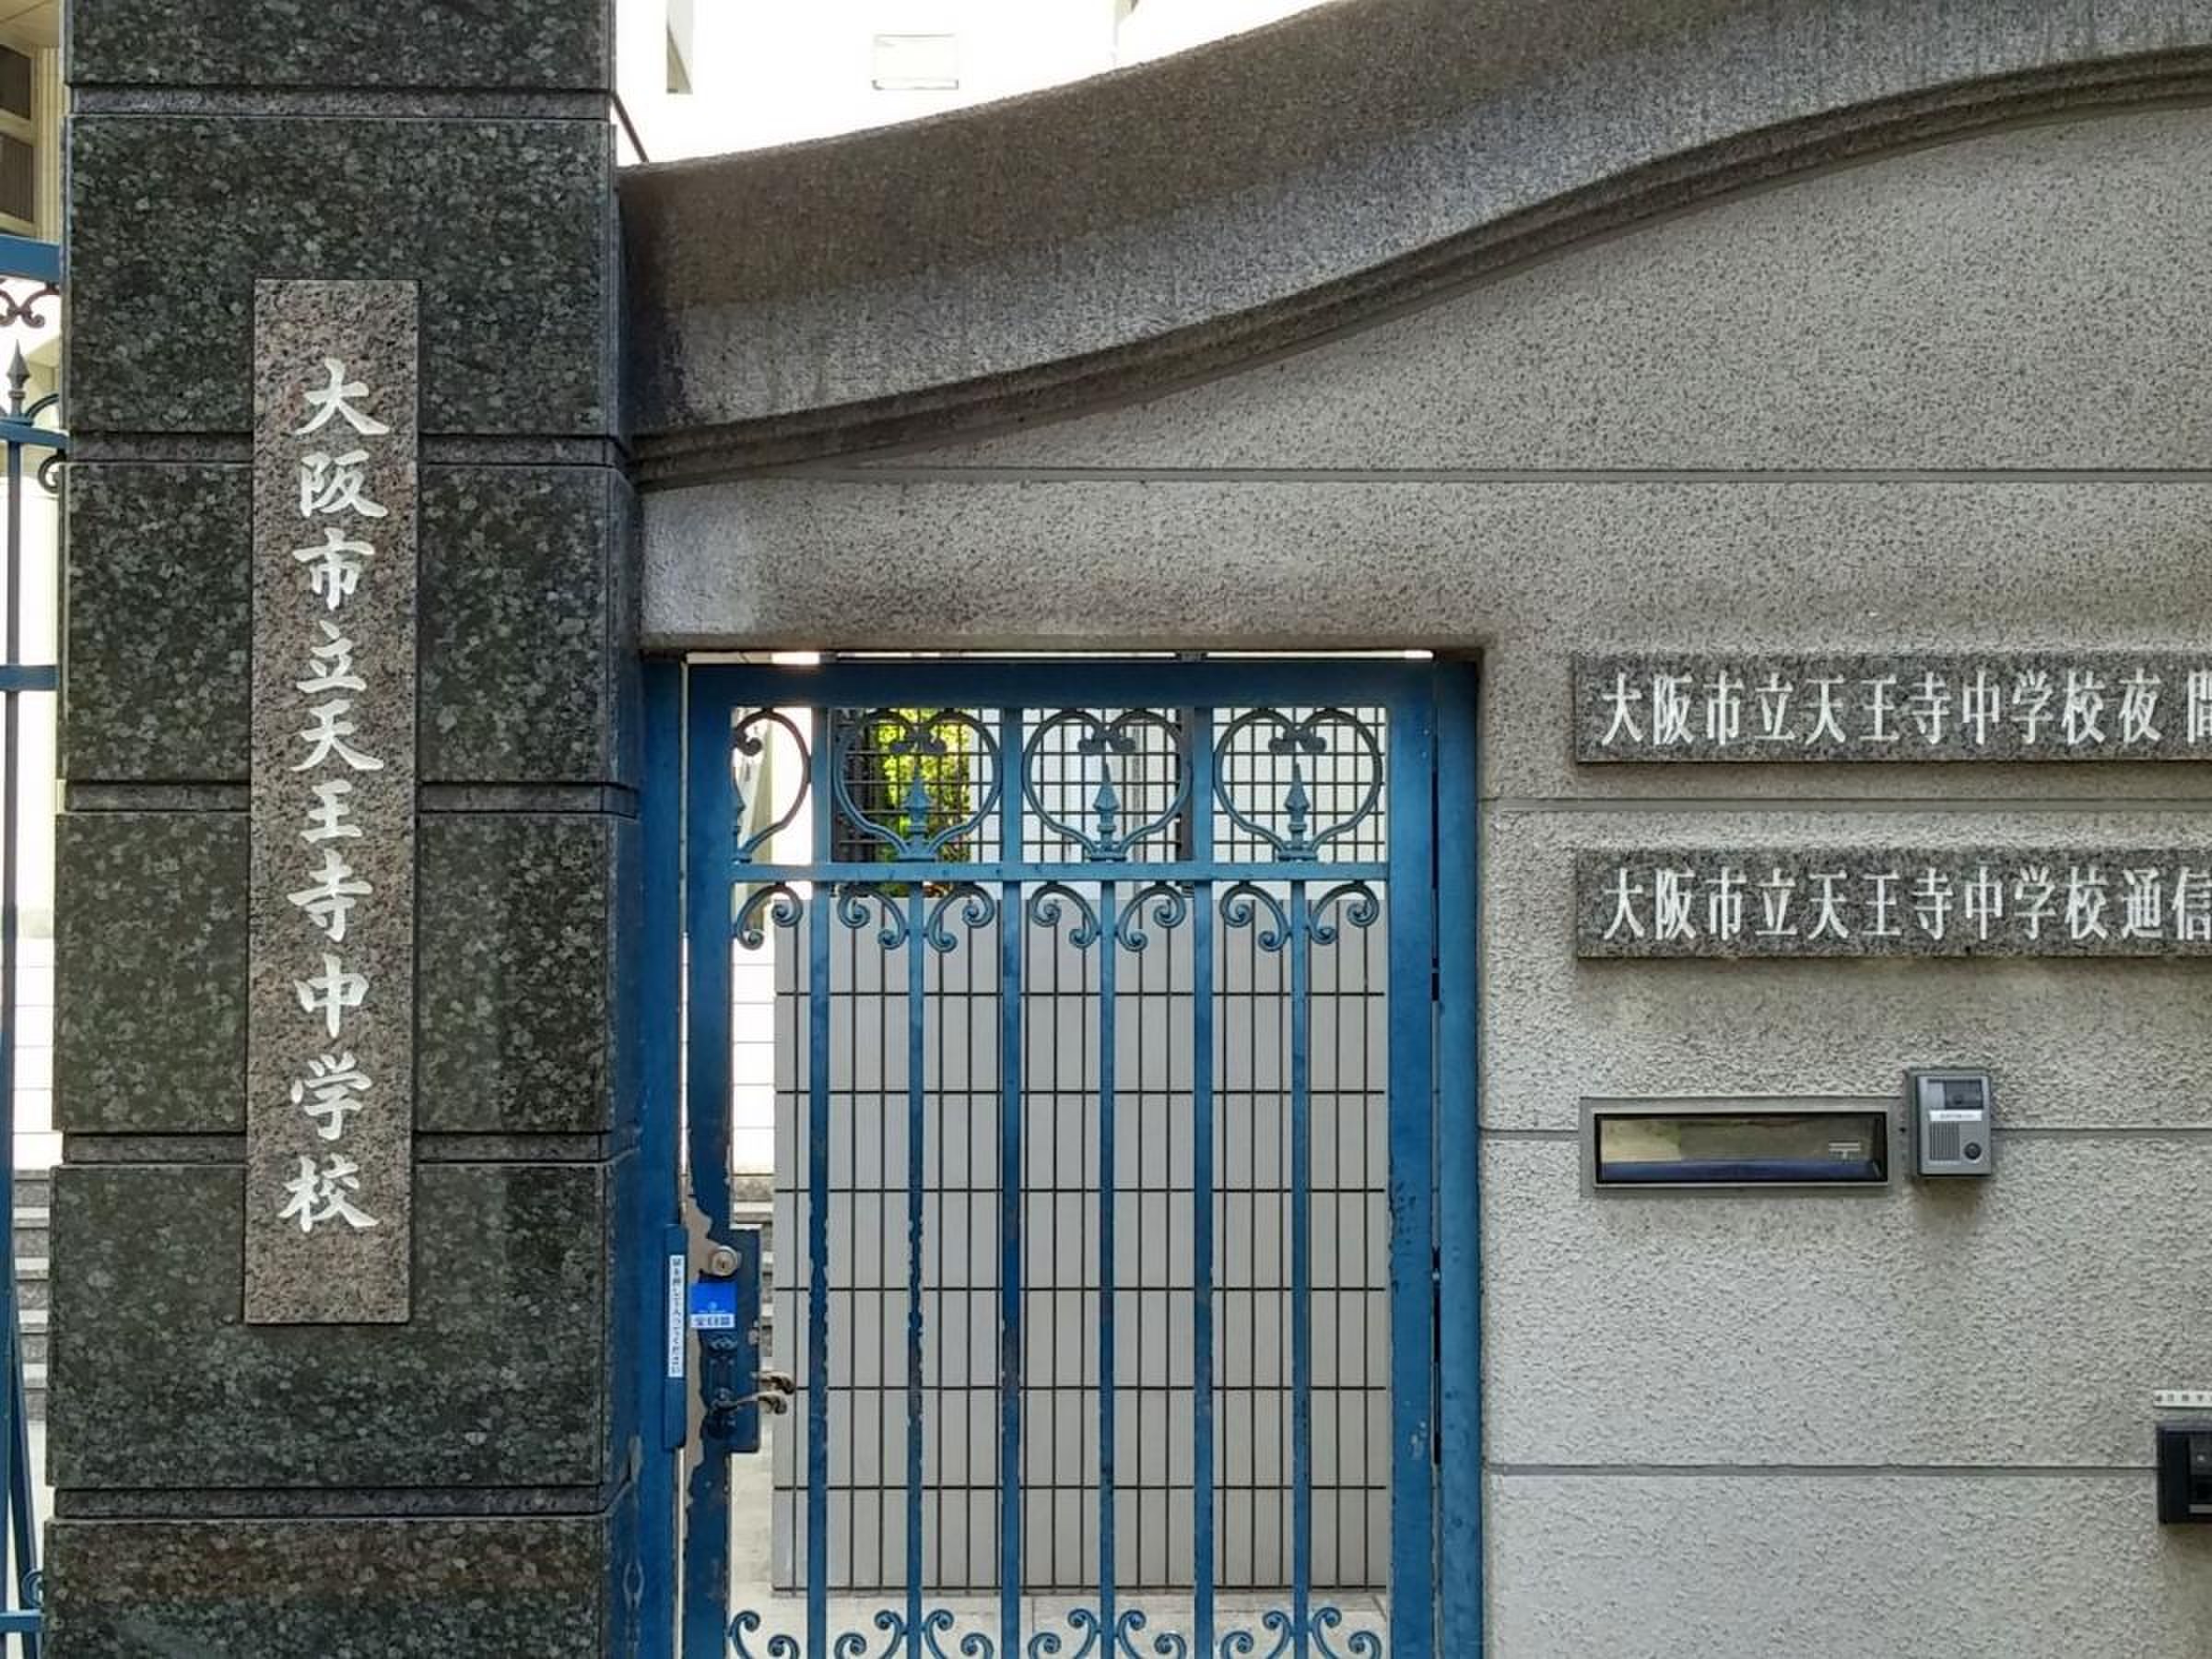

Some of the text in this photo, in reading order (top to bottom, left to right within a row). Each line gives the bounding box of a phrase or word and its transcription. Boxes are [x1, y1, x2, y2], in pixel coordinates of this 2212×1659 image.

[278, 358, 390, 1232] 大阪市立天王寺中学校
[1603, 864, 2212, 941] 大阪市立天王寺中学校通信
